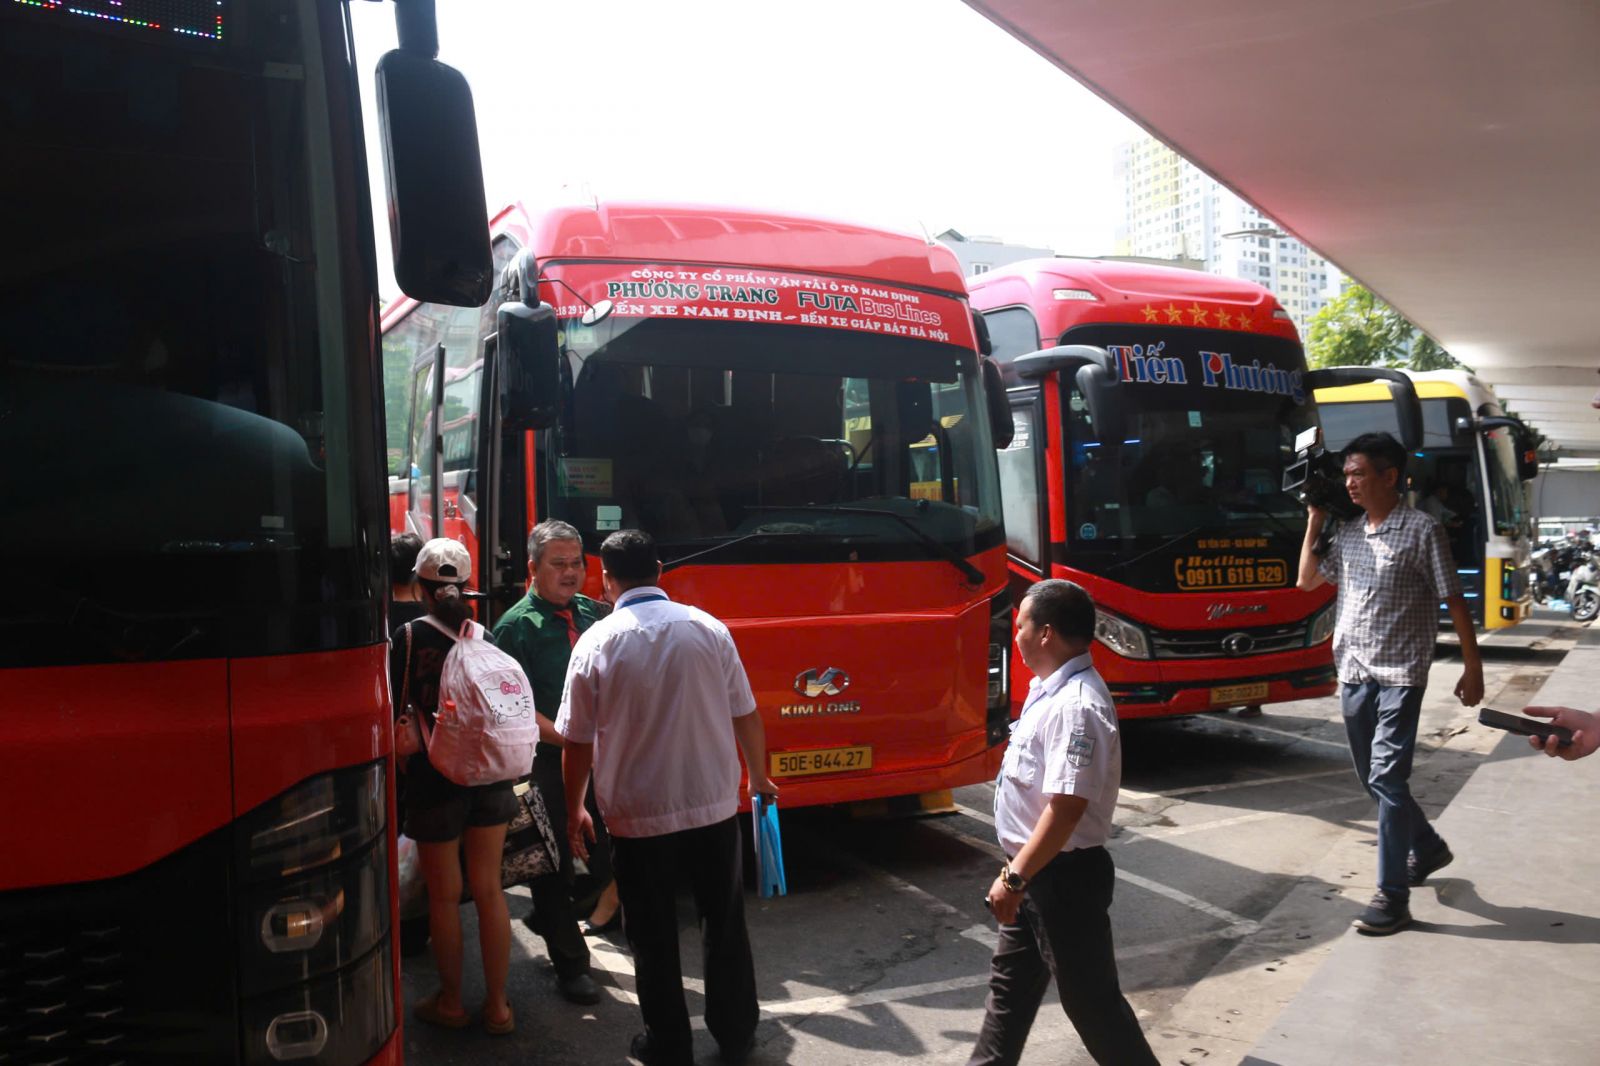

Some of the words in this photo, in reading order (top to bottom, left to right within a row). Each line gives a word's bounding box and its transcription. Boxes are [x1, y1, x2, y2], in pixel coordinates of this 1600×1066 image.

[607, 280, 700, 300] PHƯƠNG
[705, 284, 779, 305] TRANG
[797, 290, 859, 313] FUTA
[631, 268, 674, 280] CÔNG
[678, 271, 698, 280] TY
[769, 276, 800, 288] VẬN
[829, 282, 839, 292] Ô
[841, 284, 859, 294] TÔ
[861, 287, 889, 299] NAM
[891, 291, 920, 303] ĐỊNH
[649, 304, 679, 315] XE
[683, 306, 729, 318] NAM
[733, 307, 782, 321] ĐỊNH
[801, 312, 827, 324] BẾN
[830, 317, 848, 327] XE
[850, 318, 881, 330] GIÁP
[883, 321, 907, 334] BÁT
[909, 326, 927, 337] HÀ
[928, 329, 950, 341] NỘI
[1107, 341, 1188, 385] Tiến
[1198, 350, 1305, 405] Phương
[1186, 555, 1255, 566] Hotline
[1186, 569, 1222, 585] 0911
[1227, 567, 1254, 584] 619
[1257, 566, 1282, 582] 629
[780, 704, 814, 716] KIM
[818, 701, 861, 714] LONG
[779, 750, 864, 772] 50E-844.27
